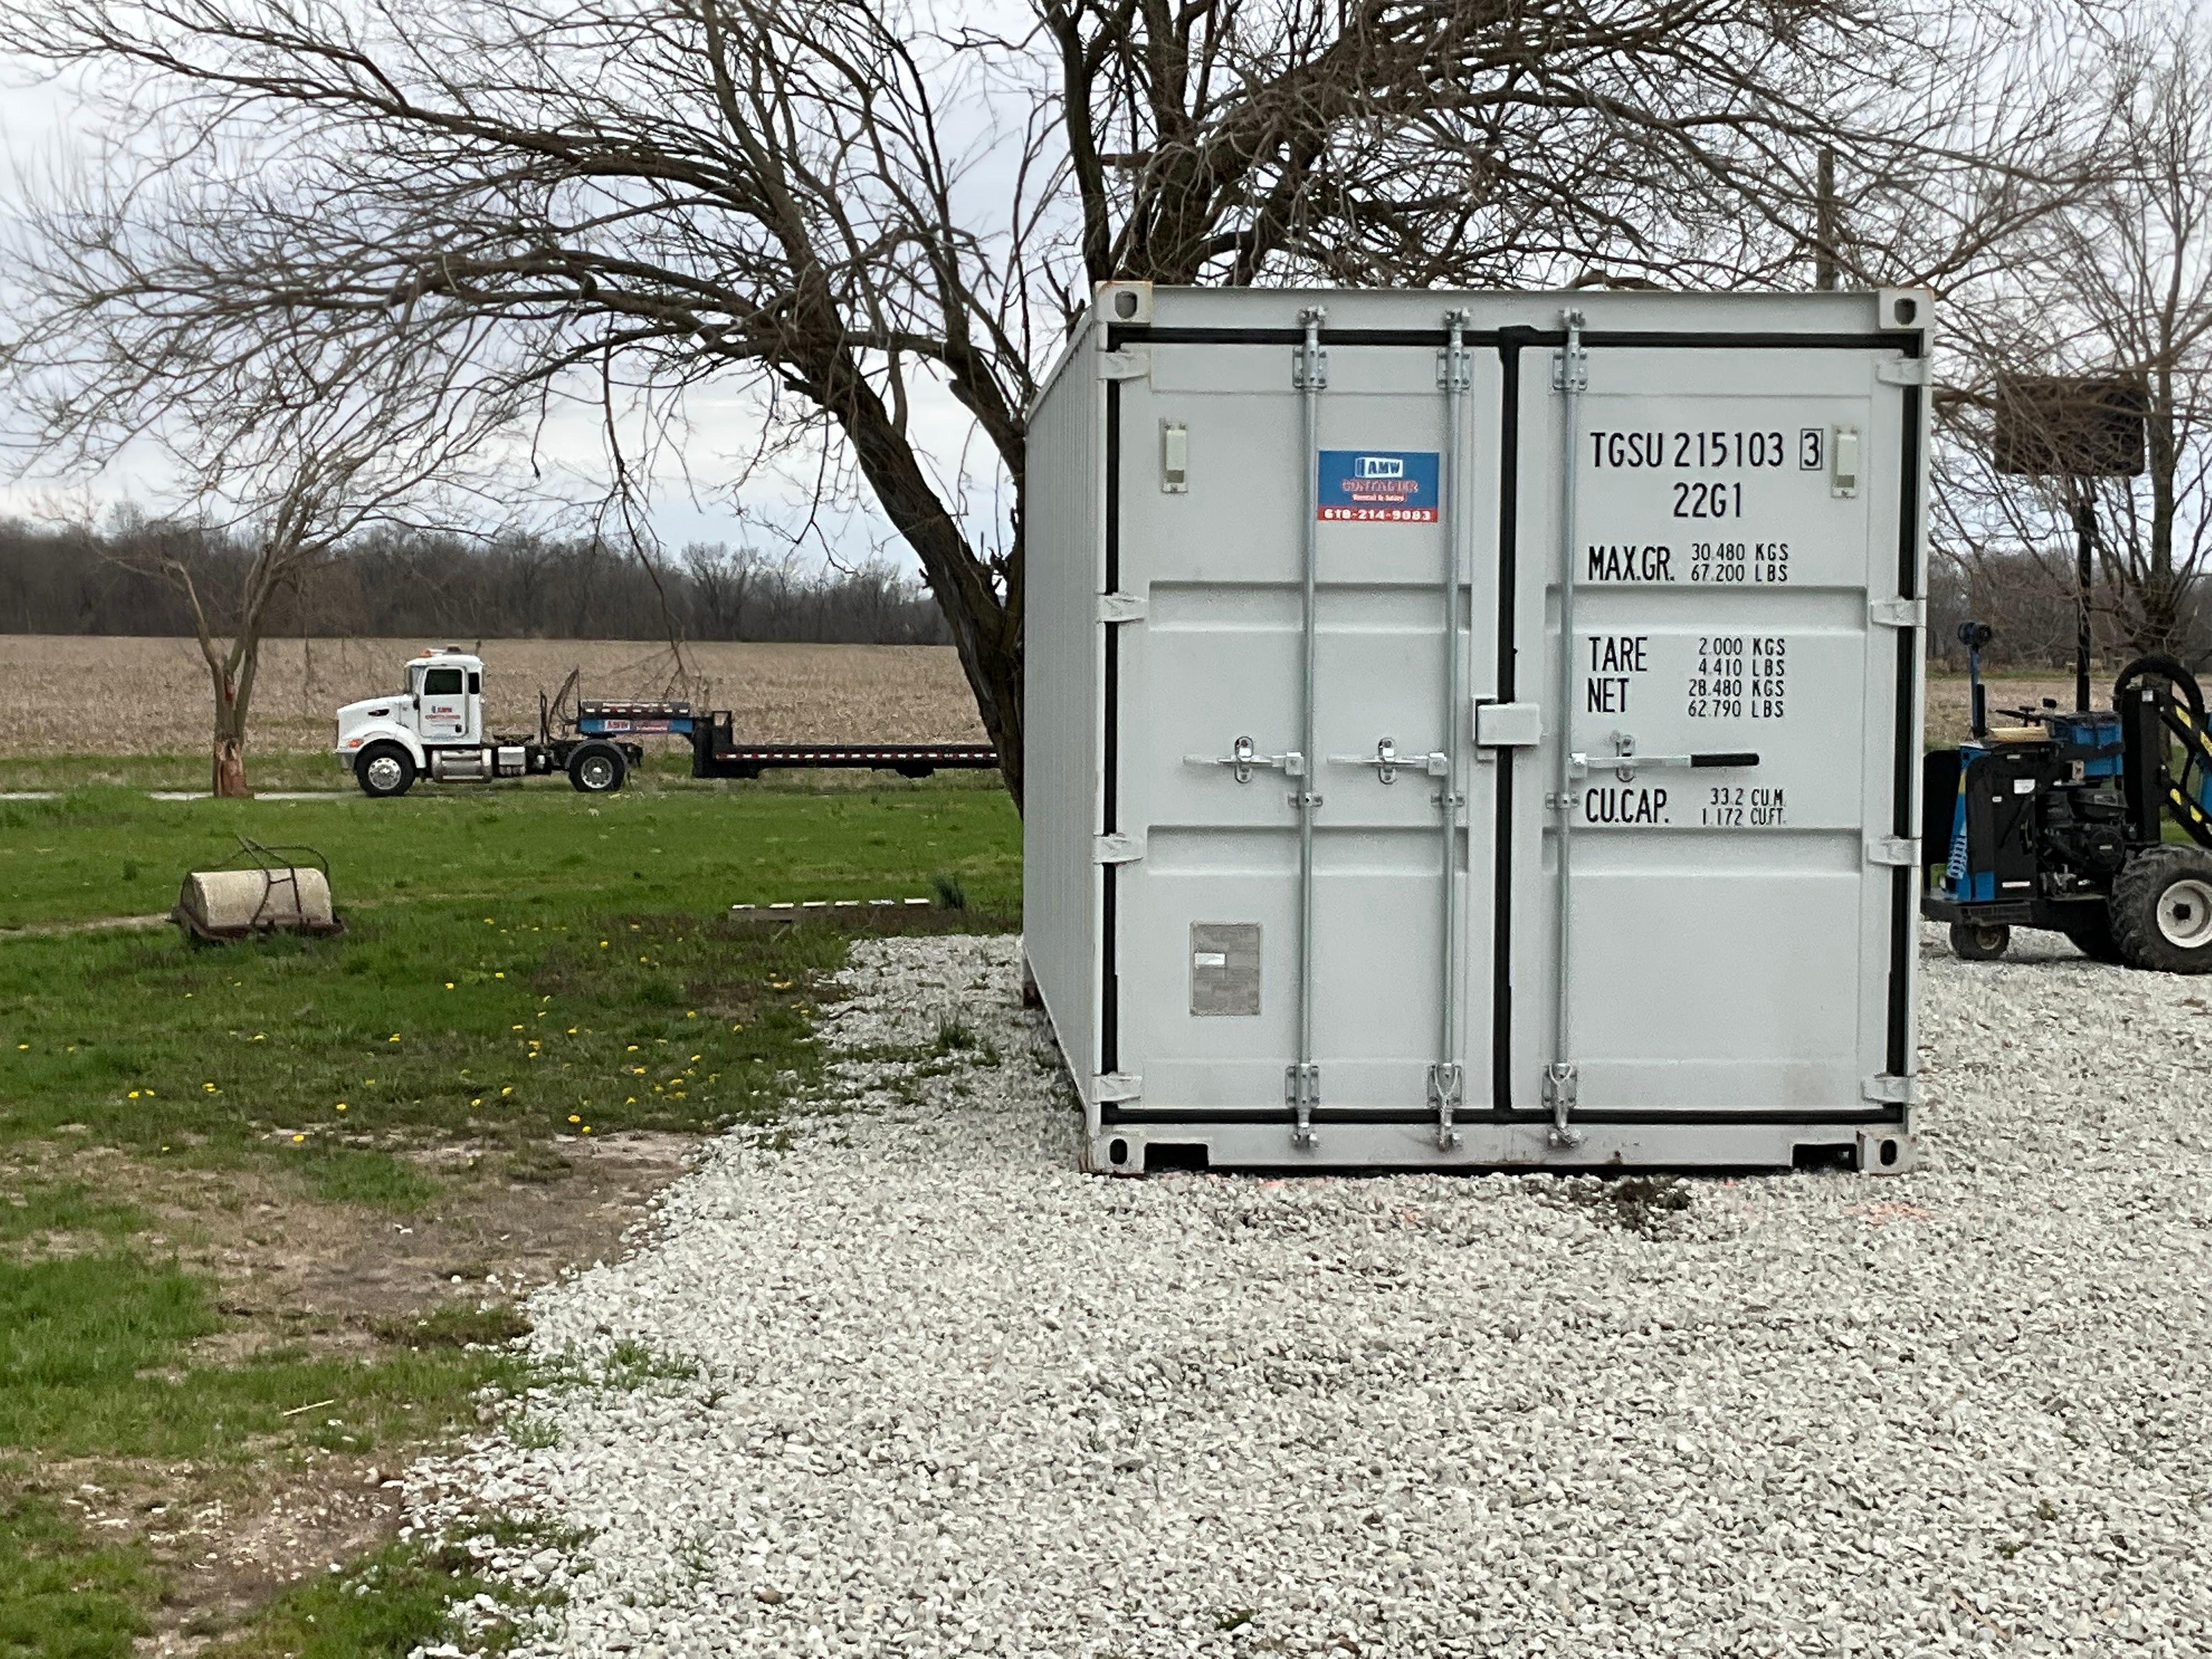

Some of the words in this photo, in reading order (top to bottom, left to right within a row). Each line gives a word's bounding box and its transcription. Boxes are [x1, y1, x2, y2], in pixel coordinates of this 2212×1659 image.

[1590, 432, 1663, 468] TGSU
[1674, 432, 1784, 467] 215103
[1804, 432, 1819, 466] 3
[1368, 461, 1400, 475] AMW
[1674, 482, 1741, 518] 22G1
[1324, 509, 1431, 521] 618-214-9083
[1692, 543, 1745, 561] 30.480
[1756, 543, 1788, 561] KGS
[1589, 545, 1674, 582] MAX.GR.
[1691, 563, 1745, 582] 67.200
[1756, 564, 1788, 582] LBS
[1588, 636, 1647, 672] TARE
[1699, 637, 1742, 656] 2.000
[1753, 638, 1785, 656] KGS
[1699, 658, 1742, 676] 4.410
[1753, 658, 1784, 677] LBS
[1588, 678, 1629, 713] NET
[1689, 679, 1742, 697] 28.480
[1752, 680, 1785, 697] KGS
[1688, 699, 1741, 717] 62.790
[1752, 699, 1784, 718] LBS
[1586, 788, 1669, 823] CU.CAP.
[1711, 788, 1743, 806] 33.2
[1702, 808, 1742, 826] 1.172
